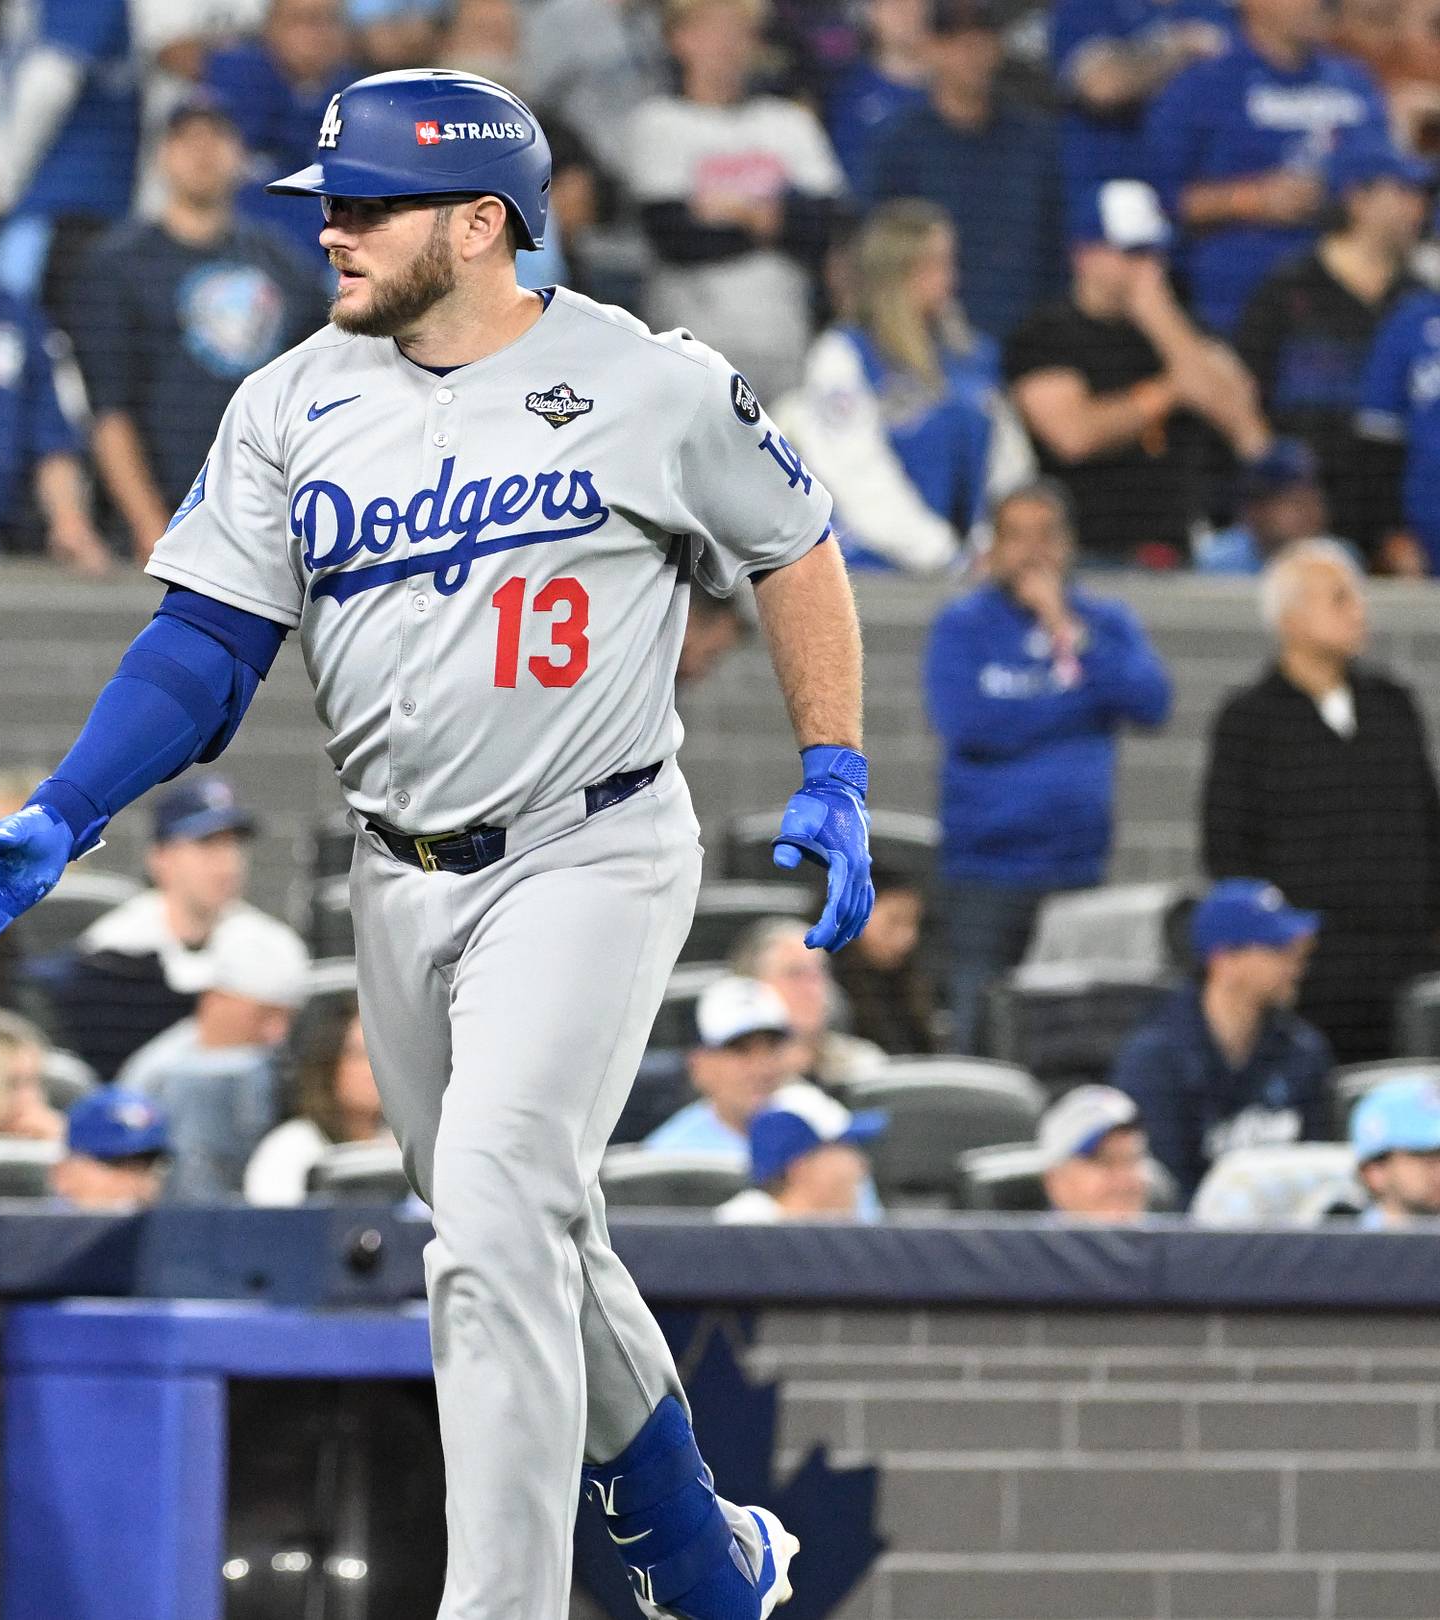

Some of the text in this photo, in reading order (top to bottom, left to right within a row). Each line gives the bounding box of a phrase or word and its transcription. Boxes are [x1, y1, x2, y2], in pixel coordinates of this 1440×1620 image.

[443, 122, 526, 141] STRAUSS
[528, 393, 591, 416] World Series
[290, 455, 610, 608] Dodgers
[492, 576, 591, 688] 13
